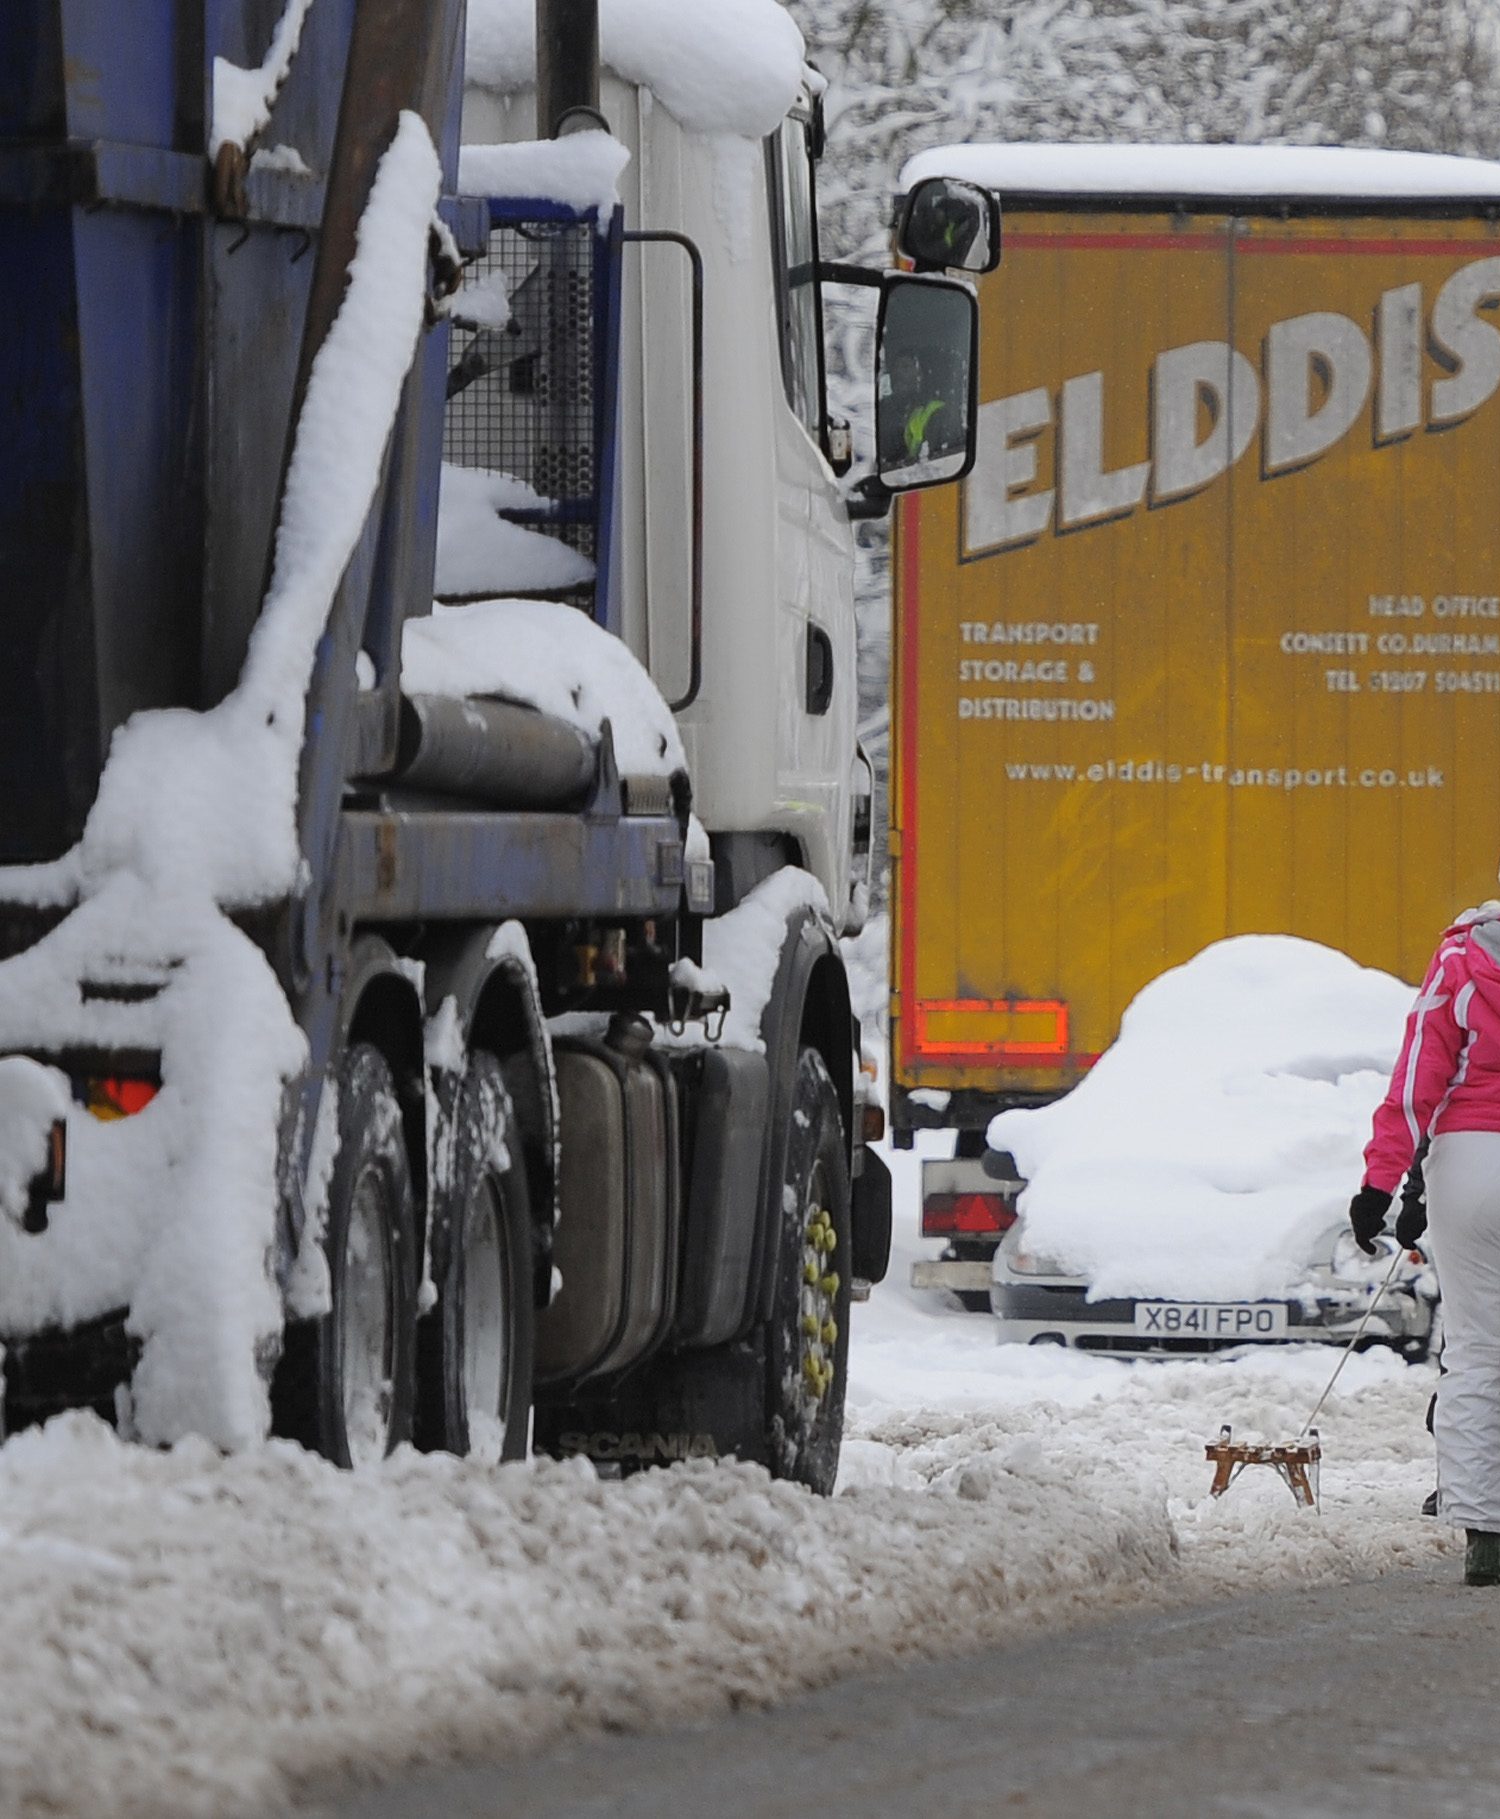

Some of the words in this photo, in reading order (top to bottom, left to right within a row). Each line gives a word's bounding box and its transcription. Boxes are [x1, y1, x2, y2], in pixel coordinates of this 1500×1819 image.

[1368, 595, 1425, 617] HEAD
[1432, 595, 1500, 619] OFFICE
[960, 621, 1099, 645] TRANSPORT
[1280, 631, 1369, 654] CONSETT
[959, 659, 1068, 682] STORAGE
[1077, 661, 1096, 682] &
[1326, 670, 1361, 692] TEL
[958, 697, 1116, 721] DISTRIBUTION
[1005, 760, 1444, 792] www.elddis-transport.co.uk
[1145, 1308, 1208, 1331] X841
[1217, 1309, 1273, 1332] FPO
[558, 1431, 720, 1459] SCANIA
